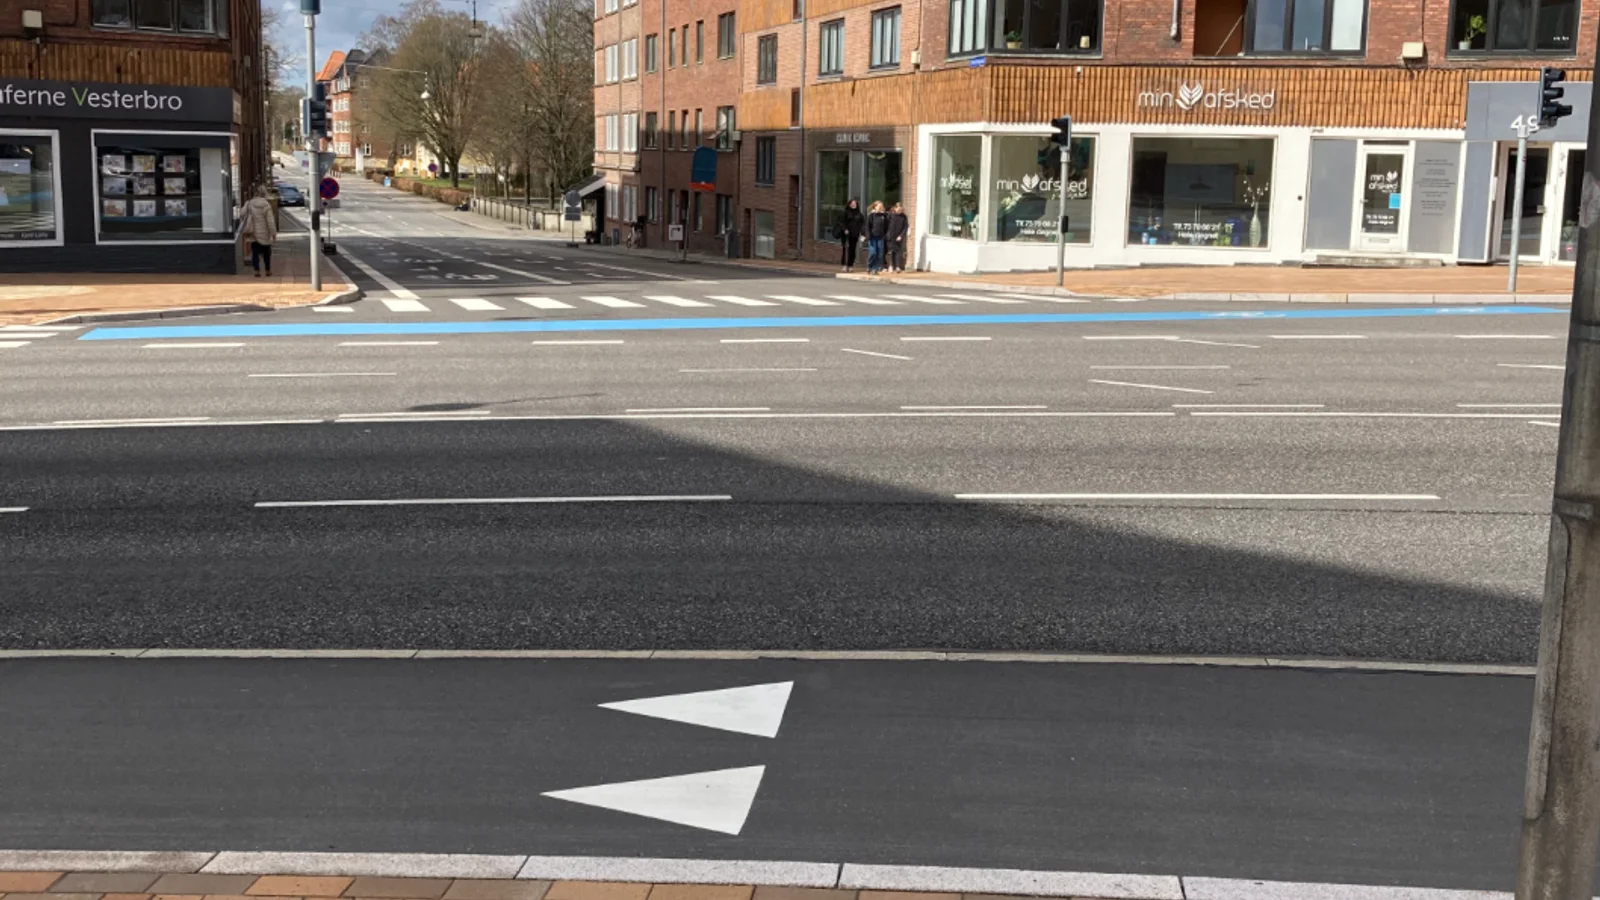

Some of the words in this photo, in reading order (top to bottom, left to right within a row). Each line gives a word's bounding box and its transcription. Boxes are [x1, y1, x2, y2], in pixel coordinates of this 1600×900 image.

[71, 87, 183, 110] Vesterbro
[1138, 88, 1173, 107] min
[1203, 88, 1275, 109] afsked
[996, 179, 1019, 191] min
[1039, 177, 1088, 193] afsed
